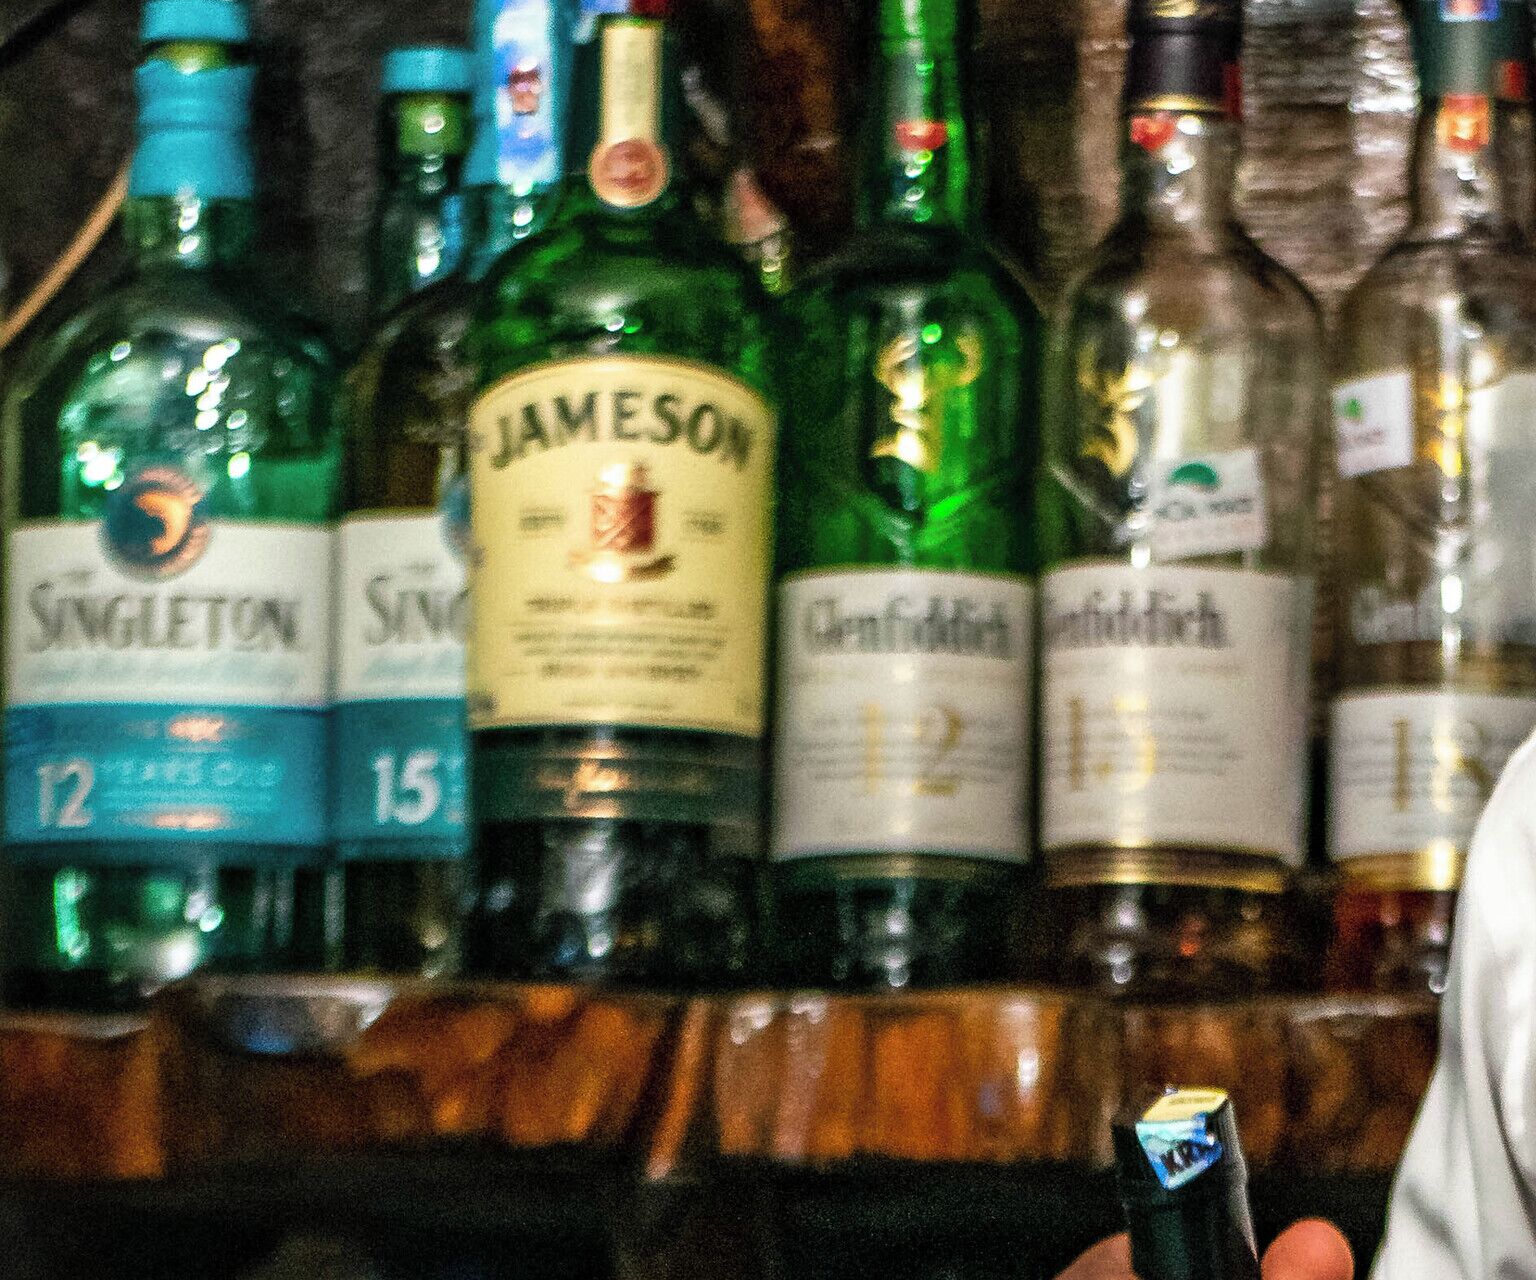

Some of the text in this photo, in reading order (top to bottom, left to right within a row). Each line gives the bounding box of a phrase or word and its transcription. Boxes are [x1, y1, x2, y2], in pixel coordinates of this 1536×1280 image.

[489, 387, 755, 472] JAMESON
[37, 759, 95, 830] 12
[372, 748, 442, 826] 15
